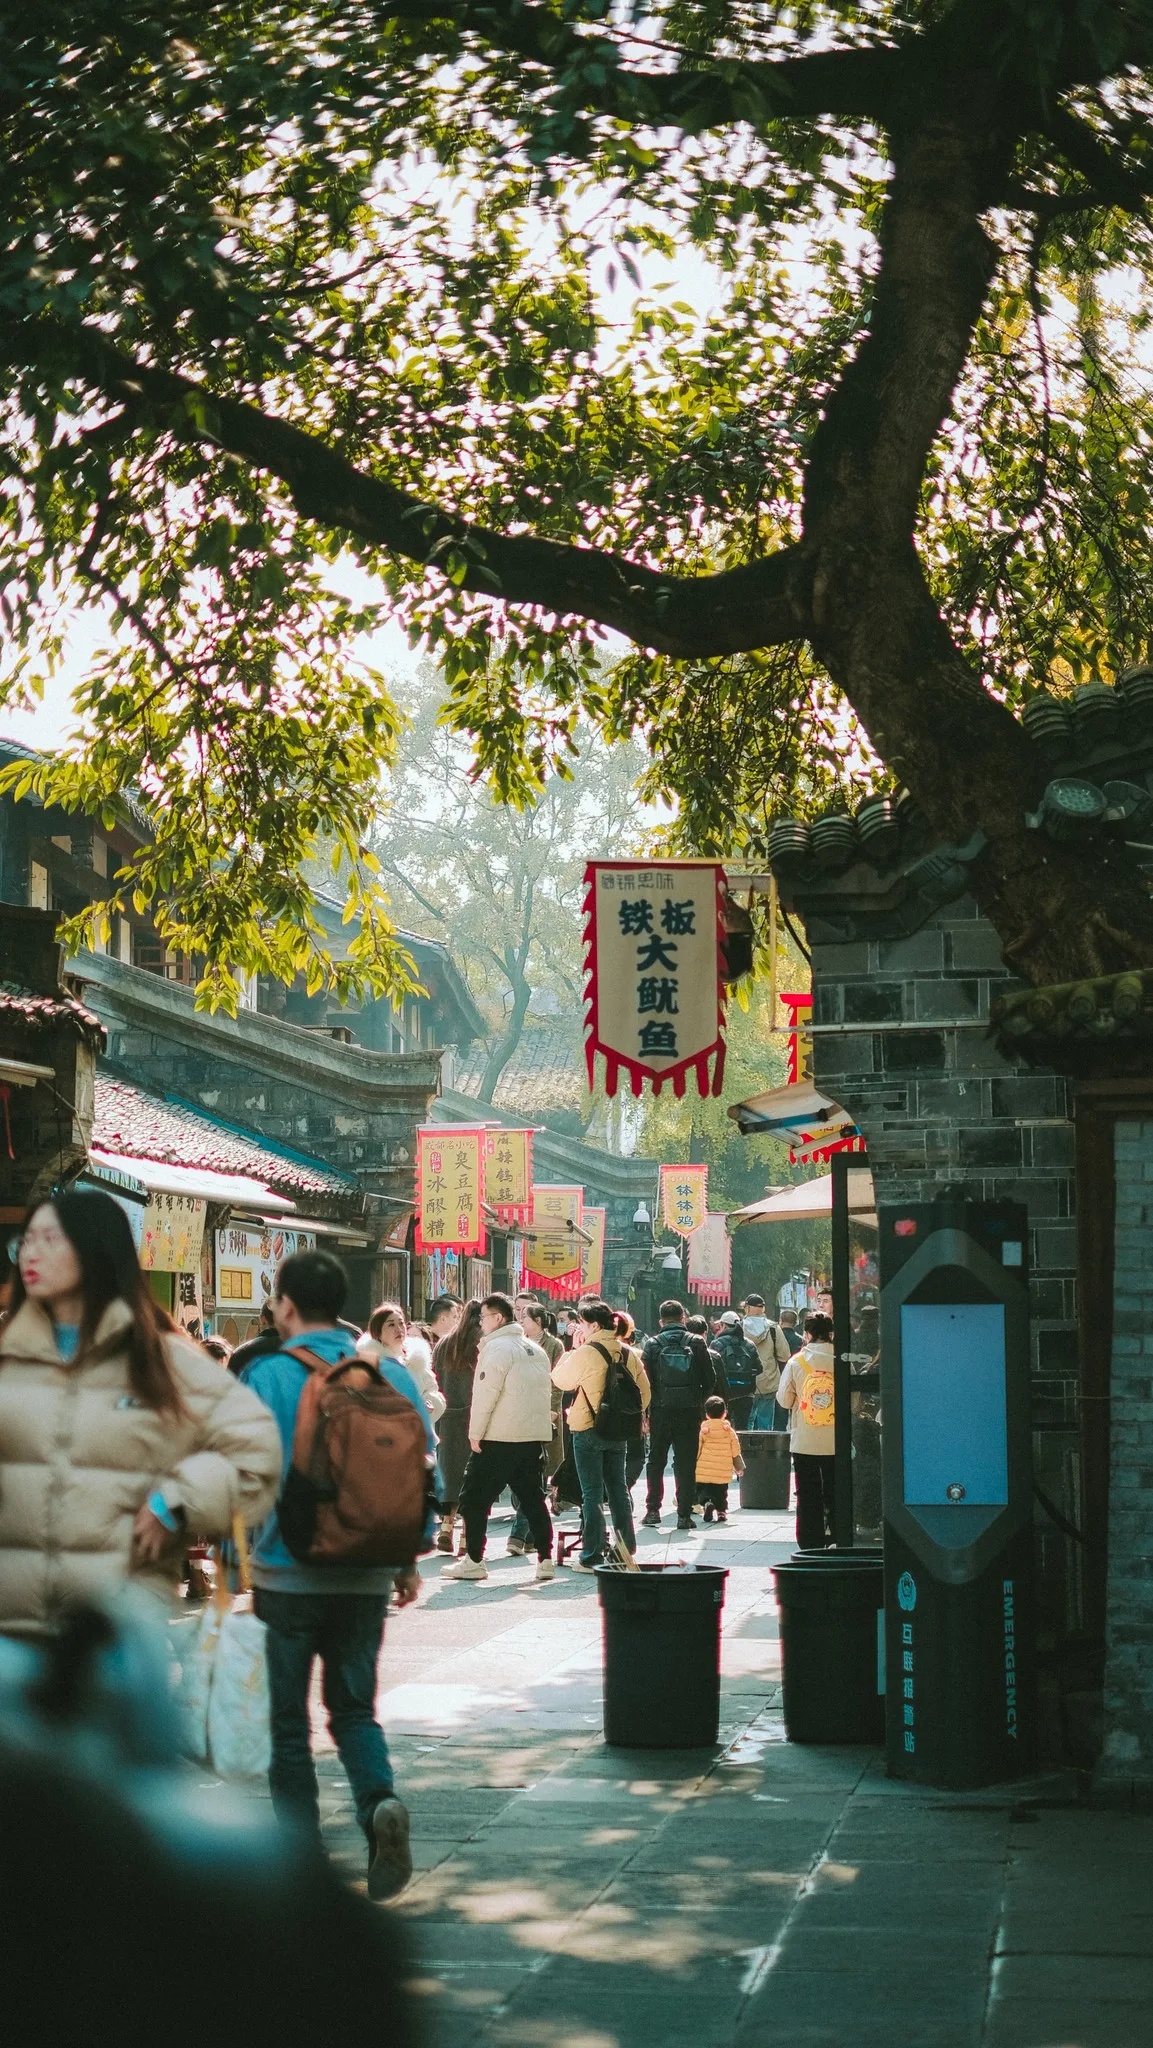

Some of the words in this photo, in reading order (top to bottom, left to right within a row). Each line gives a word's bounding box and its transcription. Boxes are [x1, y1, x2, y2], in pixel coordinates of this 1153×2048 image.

[618, 899, 696, 936] 铁板
[636, 934, 680, 1058] 大鱿鱼
[426, 1175, 447, 1238] 冰醪糟
[454, 1150, 473, 1212] 臭豆腐
[676, 1184, 694, 1227] 钵钵鸡
[1003, 1580, 1017, 1739] EMERGENCY
